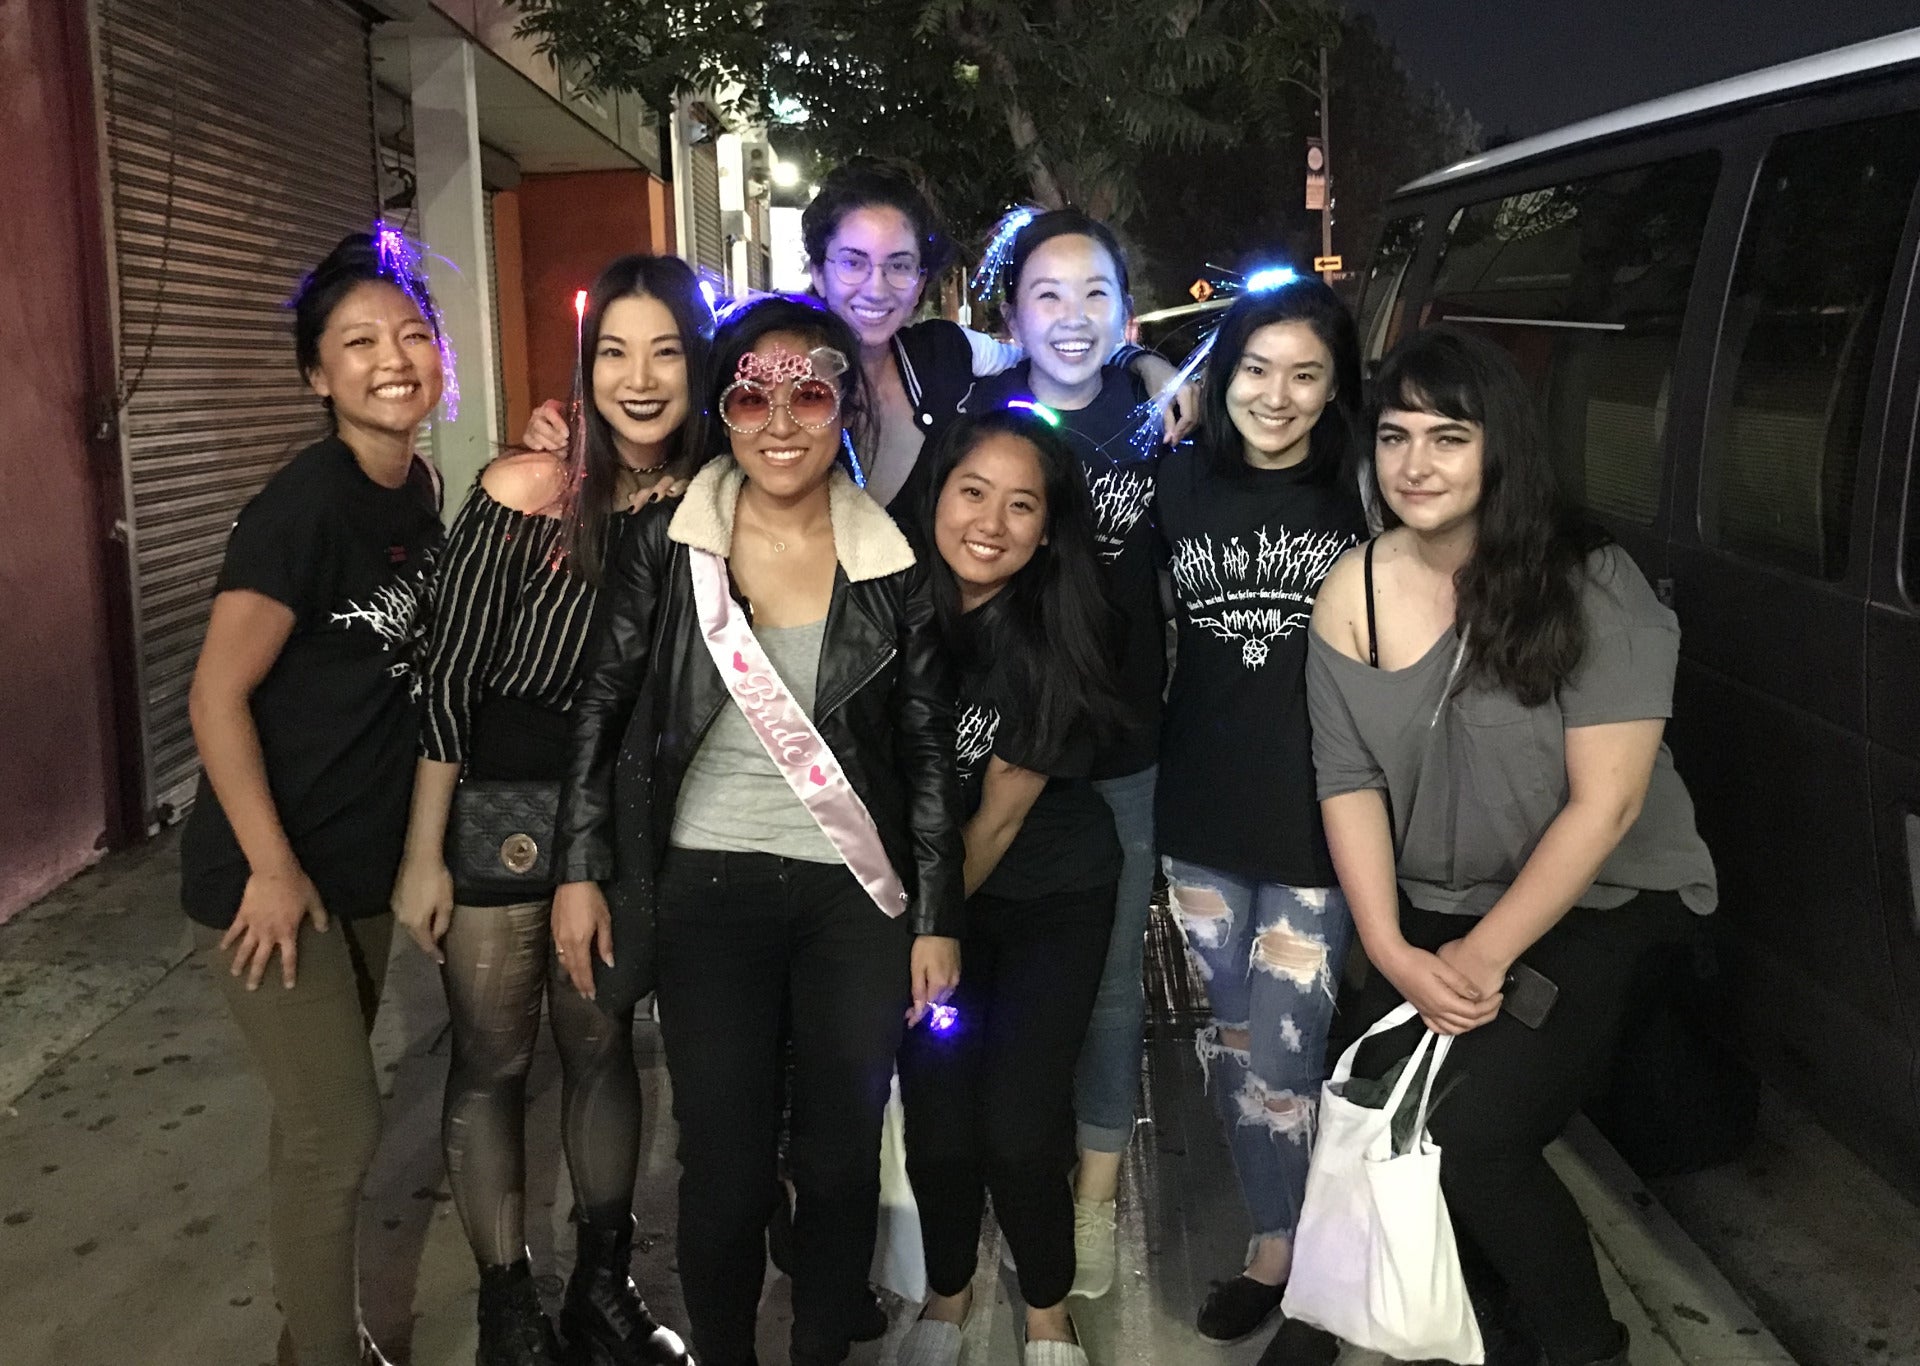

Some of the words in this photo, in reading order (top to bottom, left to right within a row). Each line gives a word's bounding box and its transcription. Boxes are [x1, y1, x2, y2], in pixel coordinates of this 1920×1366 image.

[1222, 542, 1250, 581] AND
[1254, 524, 1359, 590] RACHEL'
[1221, 607, 1282, 634] MMXVIII
[735, 672, 816, 767] Bride
